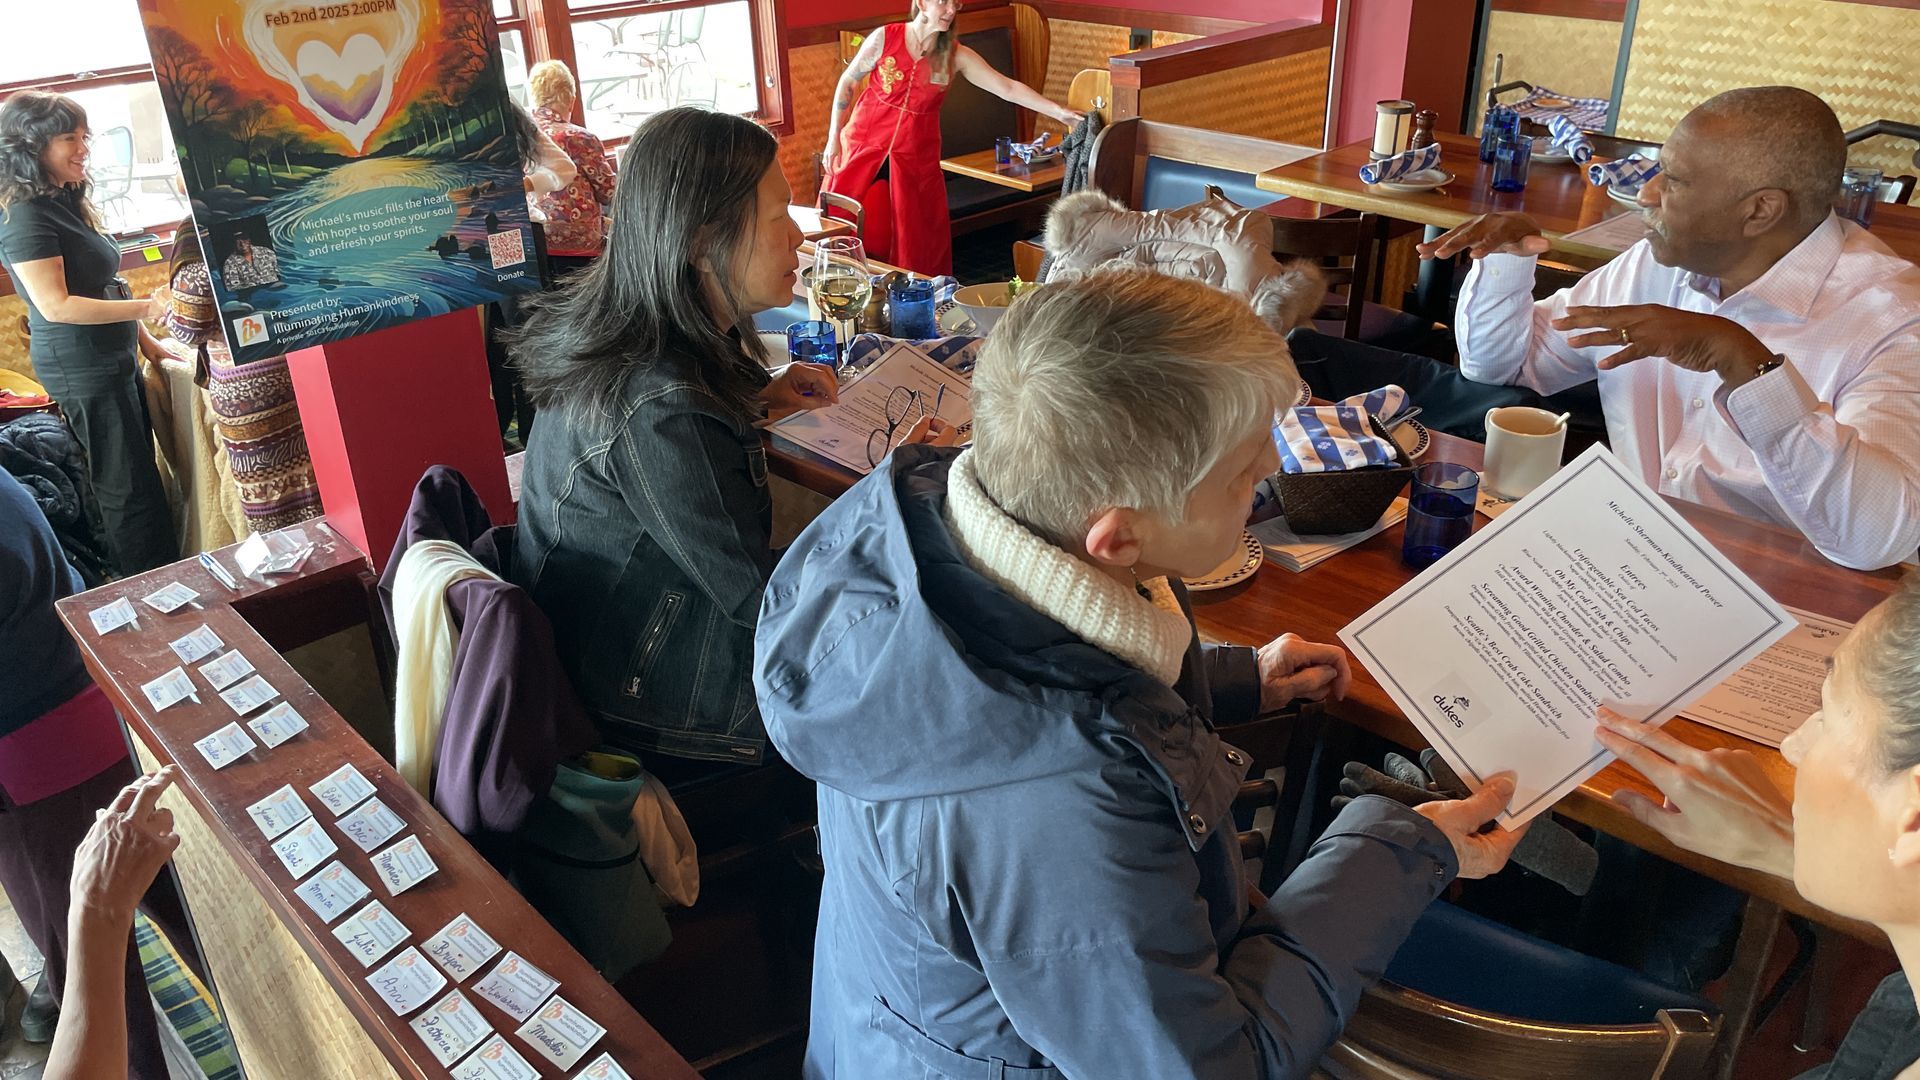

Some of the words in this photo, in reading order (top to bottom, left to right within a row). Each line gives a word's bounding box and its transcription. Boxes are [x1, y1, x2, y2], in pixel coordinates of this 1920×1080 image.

[265, 12, 290, 27] Feb
[293, 8, 317, 23] 2nd
[319, 6, 350, 20] 2025
[352, 0, 397, 15] 2:00PM
[301, 213, 352, 231] Michael's
[353, 206, 385, 221] music
[386, 203, 404, 215] fills
[405, 198, 422, 211] the
[423, 193, 451, 207] heart
[304, 231, 329, 244] with
[330, 226, 358, 241] hope
[359, 222, 371, 233] to
[372, 215, 407, 230] soothe
[408, 211, 431, 225] your
[432, 204, 454, 218] soul
[308, 244, 329, 257] and
[330, 236, 367, 252] refresh
[368, 231, 392, 246] your
[393, 225, 428, 241] spirits.
[497, 270, 525, 282] Donate
[270, 300, 325, 321] Presented
[326, 296, 343, 308] by:
[273, 311, 339, 335] Illuminating
[339, 292, 420, 318] Humankindness
[282, 333, 304, 344] private
[325, 320, 360, 333] foundation
[1605, 499, 1636, 527] Michelle
[1631, 523, 1704, 590] Sherman-Kindhearted
[1700, 587, 1725, 609] Power
[1571, 547, 1617, 590] Unforgettable
[1612, 586, 1628, 601] Sea
[1624, 598, 1643, 614] Cod
[1638, 612, 1661, 632] Tacos
[1619, 563, 1650, 590] Entrees
[1509, 563, 1533, 586] Award
[1528, 584, 1558, 612] Winning
[1554, 609, 1585, 639] Chowder
[1581, 636, 1591, 644] &
[1588, 643, 1611, 664] Salad
[1606, 661, 1632, 686] Combo
[1553, 568, 1566, 580] Oh
[1562, 578, 1577, 591] My
[1574, 588, 1593, 606] Cod!
[1589, 604, 1608, 620] Fish
[1604, 618, 1614, 627] &
[1610, 625, 1634, 647] Chips
[1478, 581, 1513, 616] Screaming
[1509, 613, 1530, 633] Good
[1526, 630, 1551, 654] Grilled
[1547, 652, 1576, 680] Chicken
[1462, 614, 1491, 642] Seattle's
[1487, 640, 1504, 656] Best
[1500, 654, 1519, 672] Crab
[1515, 670, 1535, 689] Cake
[1530, 686, 1564, 719] Sandwich
[1431, 691, 1468, 728] dukes
[347, 819, 369, 844] Eric
[380, 852, 401, 888] Monica
[421, 1015, 452, 1056] Patricia
